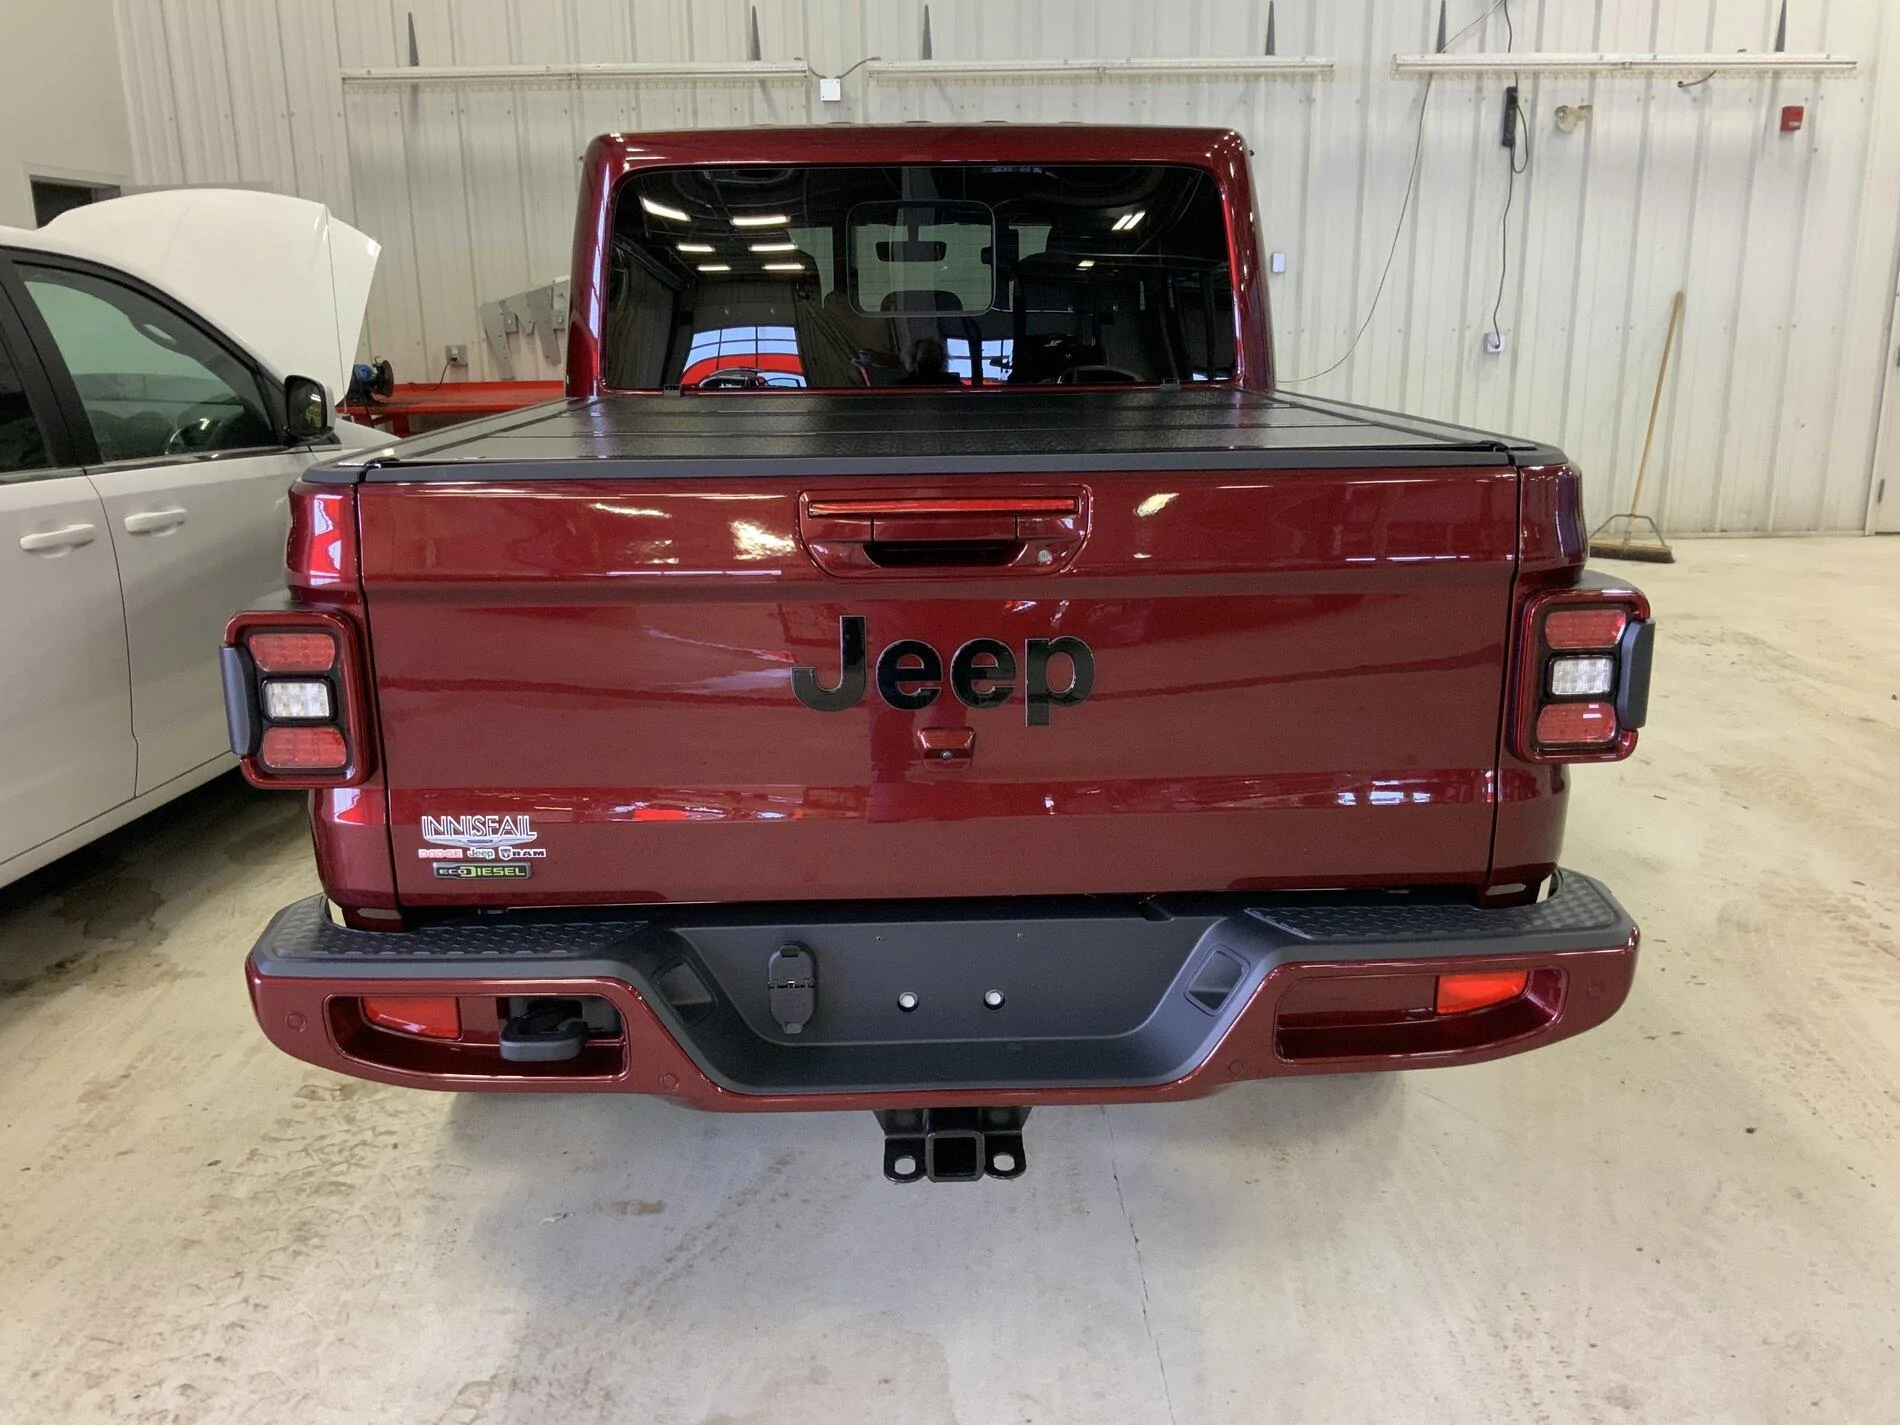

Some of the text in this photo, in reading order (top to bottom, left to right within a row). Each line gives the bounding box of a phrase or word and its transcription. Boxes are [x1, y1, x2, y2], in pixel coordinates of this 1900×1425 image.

[791, 615, 1096, 727] Jeep
[421, 815, 537, 837] INNISFAIL
[418, 847, 546, 859] DODGE Jeep RAM
[438, 866, 526, 877] ECODIESEL
